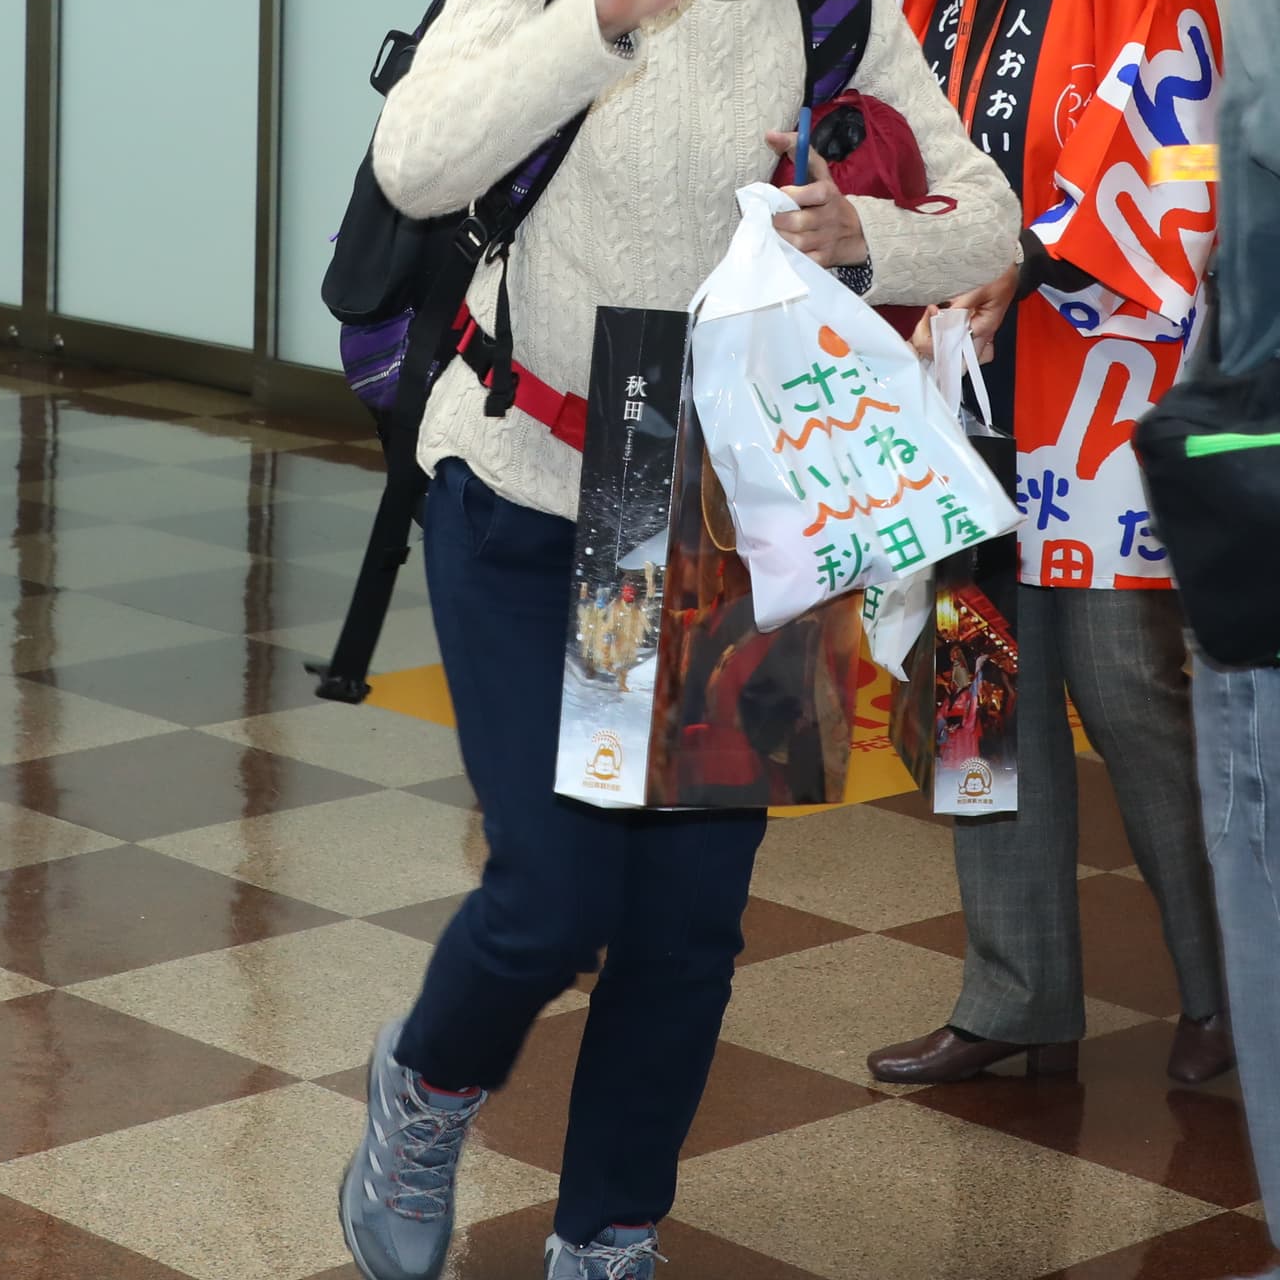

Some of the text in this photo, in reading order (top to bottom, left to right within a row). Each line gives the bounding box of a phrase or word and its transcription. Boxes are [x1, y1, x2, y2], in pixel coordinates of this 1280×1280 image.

[623, 375, 648, 422] 秋田
[753, 356, 877, 425] しこた
